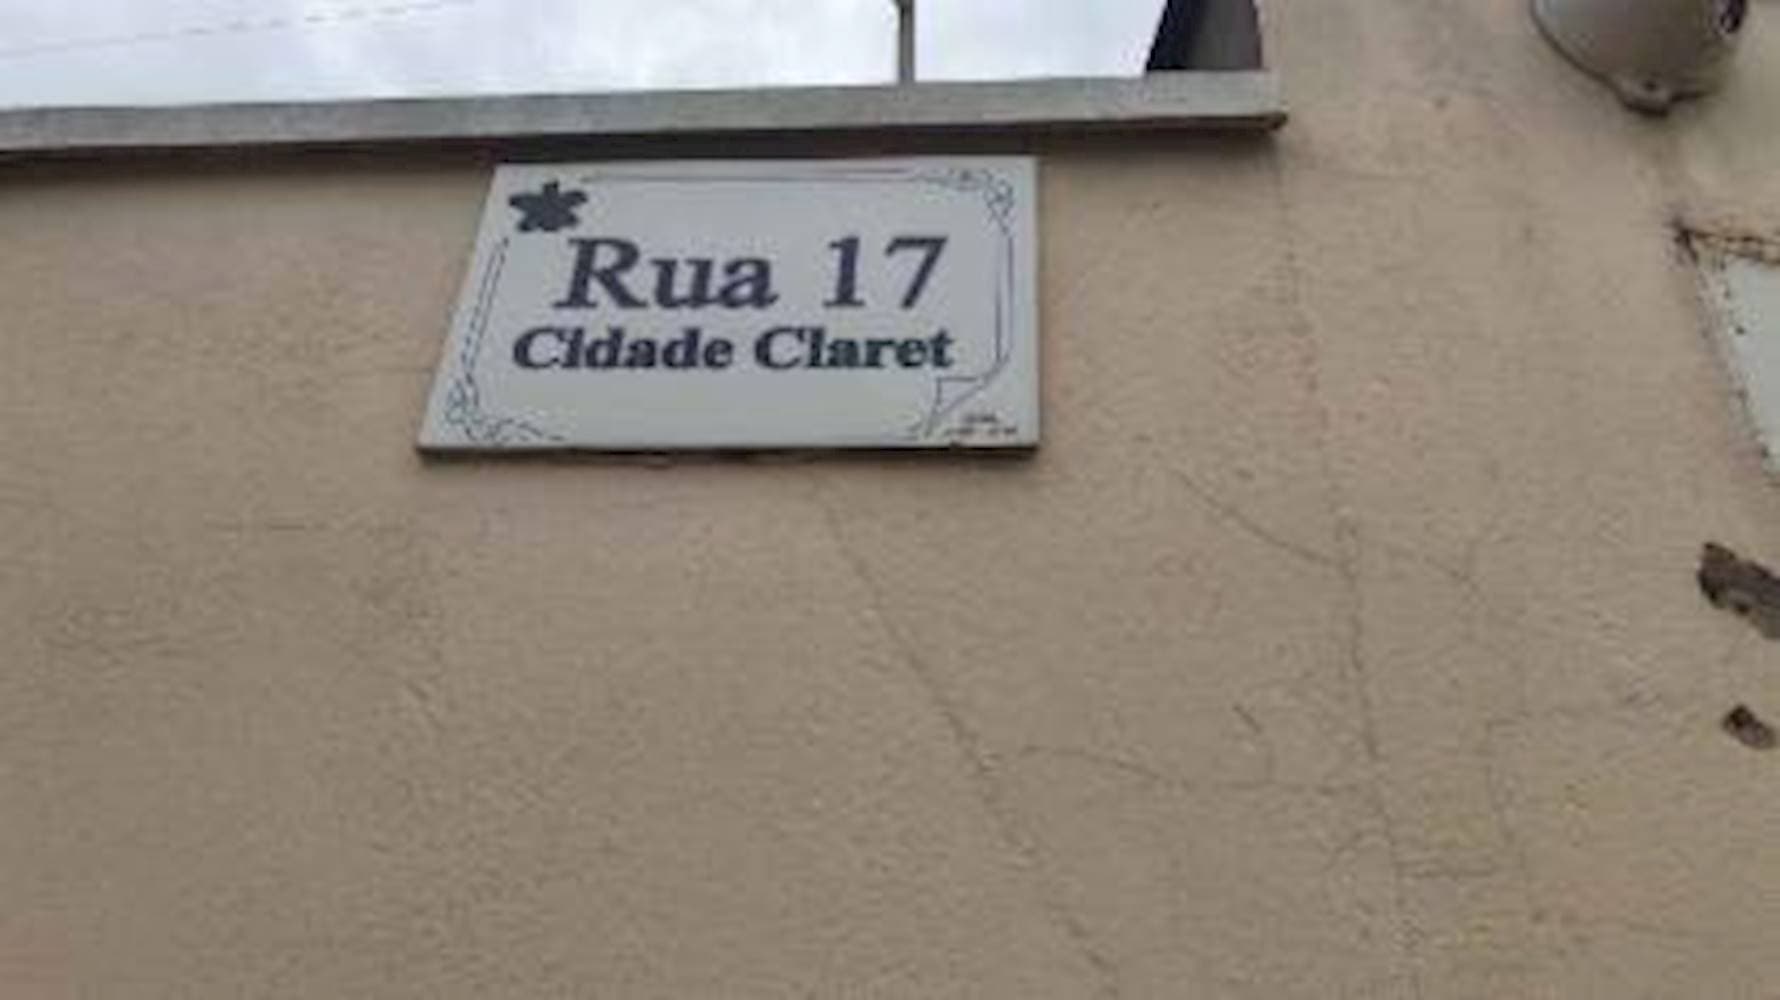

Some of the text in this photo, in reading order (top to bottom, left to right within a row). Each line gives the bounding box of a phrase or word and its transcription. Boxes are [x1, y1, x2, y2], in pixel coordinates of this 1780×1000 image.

[553, 235, 948, 310] Rua 17
[512, 326, 954, 371] Cidade Claret
